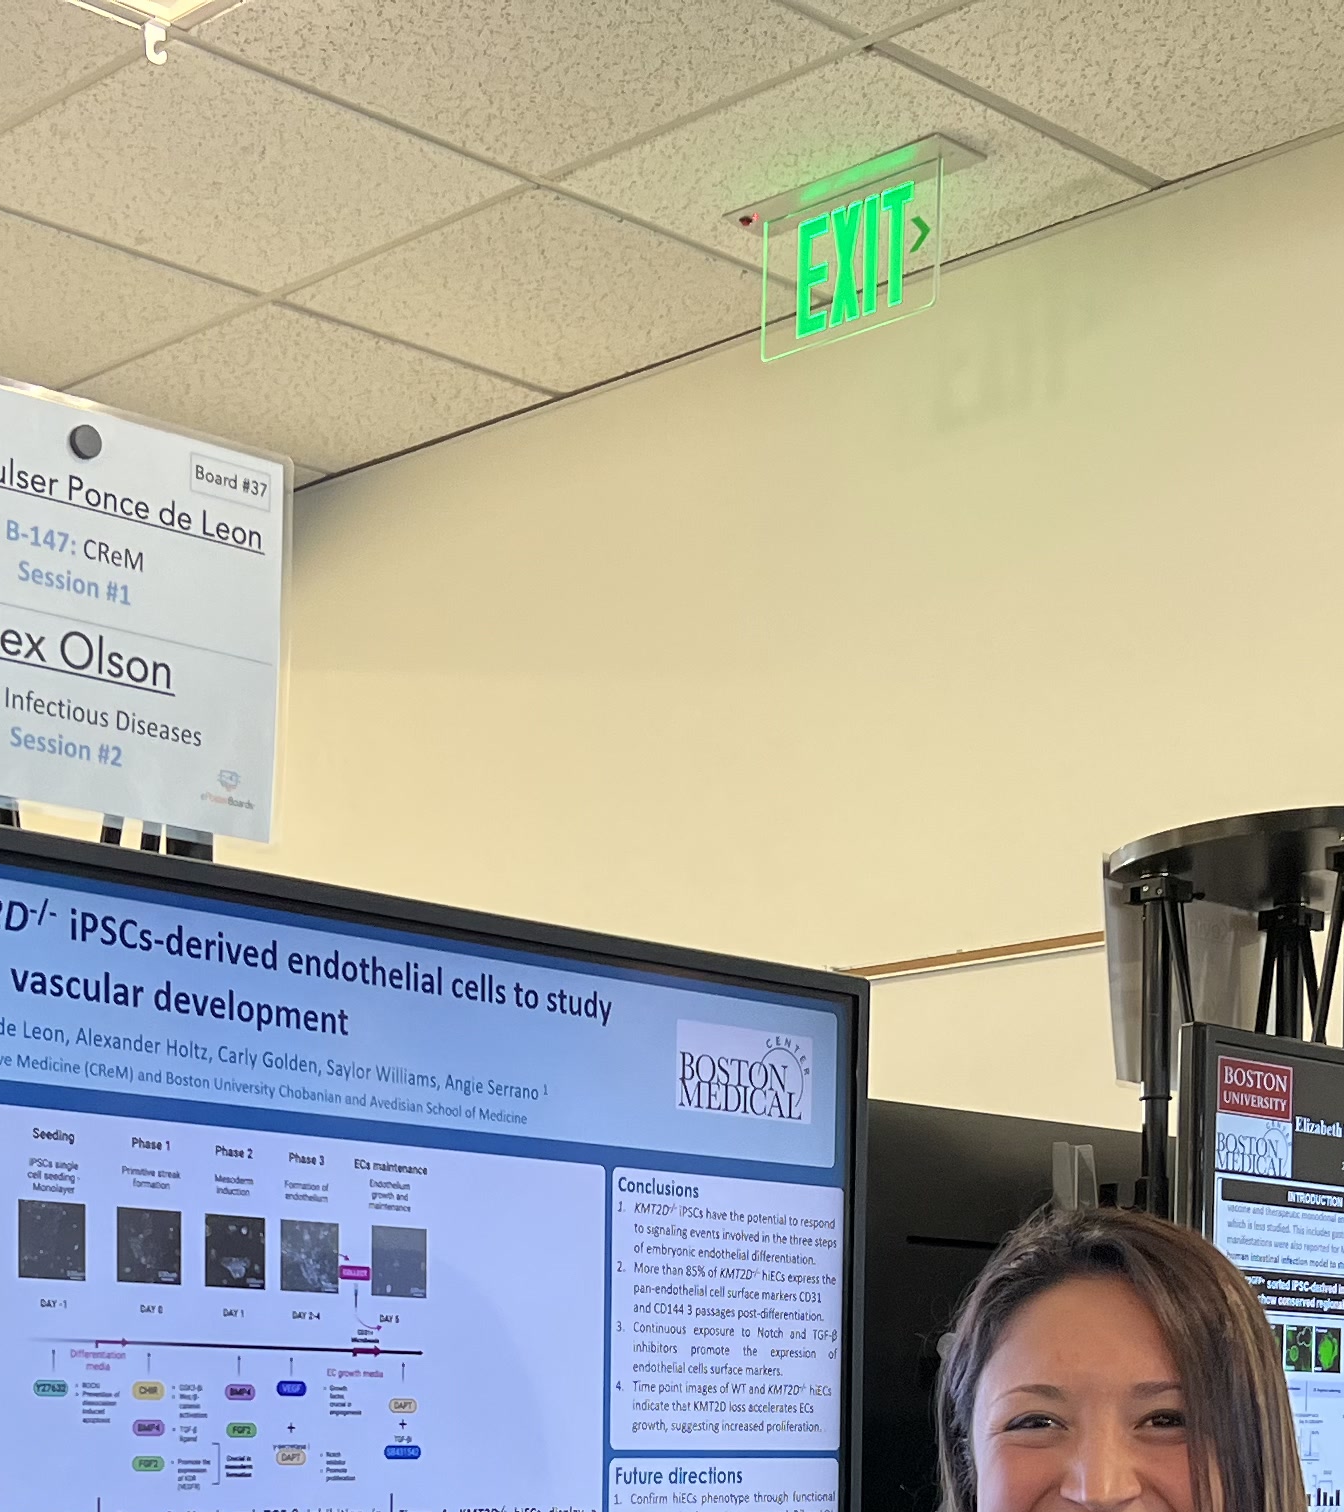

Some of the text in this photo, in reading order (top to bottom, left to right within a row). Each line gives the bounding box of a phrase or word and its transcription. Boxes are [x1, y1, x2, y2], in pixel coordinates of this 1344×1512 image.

[795, 180, 916, 340] EXIT
[194, 464, 269, 498] Board #37
[68, 475, 149, 519] Ponce
[159, 500, 192, 530] de
[202, 510, 261, 549] Leon
[6, 520, 143, 571] B-147: CReM
[17, 560, 131, 605] Session #1
[59, 631, 171, 688] Olson
[5, 687, 108, 727] Infectious
[116, 710, 201, 746] Diseases
[9, 726, 122, 767] Session #2
[70, 909, 277, 969] iPSCs-derived
[288, 951, 442, 994] endothelial
[451, 973, 506, 1004] cells
[513, 982, 538, 1008] to
[546, 989, 612, 1026] study
[10, 969, 348, 1034] vascular development
[23, 1020, 69, 1046] Leon,
[75, 1027, 161, 1053] Alexander
[166, 1038, 212, 1063] Holtz,
[217, 1045, 257, 1069] Carly
[262, 1051, 321, 1076] Golden,
[326, 1059, 371, 1080] Saylor
[375, 1065, 440, 1090] Williams,
[444, 1074, 483, 1095] Angie
[487, 1079, 538, 1100] Serrano
[678, 1051, 789, 1094] BOSTON
[16, 1054, 80, 1073] Medicine
[84, 1061, 133, 1082] (CReM)
[137, 1069, 162, 1083] and
[165, 1071, 210, 1088] Boston
[213, 1077, 275, 1098] University
[278, 1084, 341, 1103] Chobanian
[344, 1093, 366, 1106] and
[369, 1095, 423, 1112] Avedisian
[426, 1101, 462, 1117] School
[464, 1105, 476, 1118] of
[478, 1107, 527, 1124] Medicine
[1224, 1065, 1288, 1094] BOSTON
[678, 1076, 804, 1122] MEDICAL
[1223, 1090, 1288, 1112] UNIVERSITY
[32, 1127, 74, 1144] Seeding
[131, 1136, 162, 1150] Phase
[1294, 1116, 1342, 1137] Elizabeth
[215, 1145, 253, 1159] Phase 2
[288, 1152, 324, 1165] Phase 3
[1216, 1132, 1278, 1158] BOSTON
[372, 1162, 427, 1175] maintenance
[1215, 1152, 1288, 1178] MEDICAL
[617, 1176, 699, 1198] Conclusions
[1287, 1190, 1344, 1208] INTRODUCTION
[615, 1466, 742, 1484] Future directions
